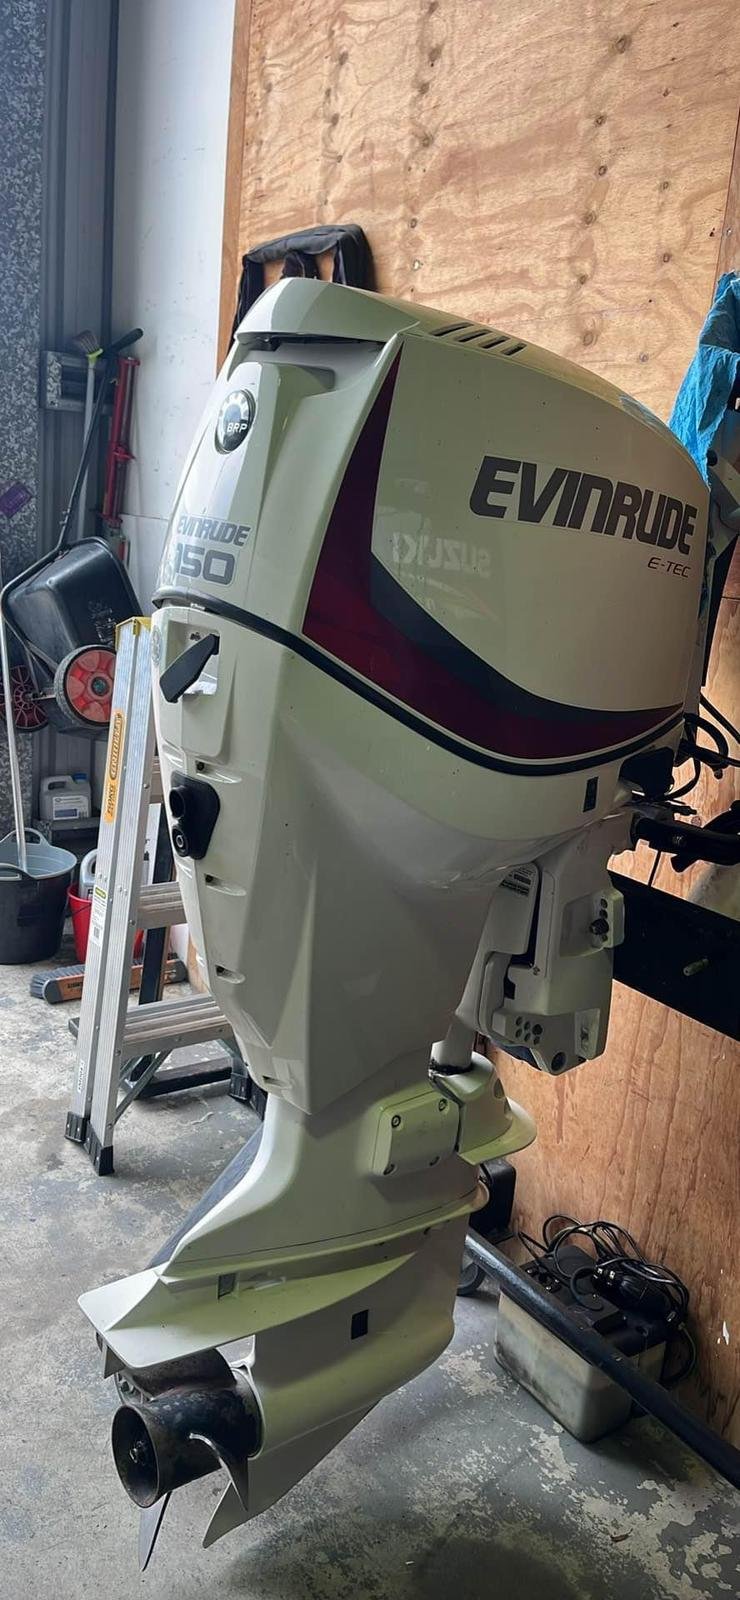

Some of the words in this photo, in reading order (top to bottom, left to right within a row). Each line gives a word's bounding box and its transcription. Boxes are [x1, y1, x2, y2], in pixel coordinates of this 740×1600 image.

[227, 422, 248, 433] BRP
[469, 455, 698, 555] EVINRUDE
[178, 516, 251, 546] EVINRUDE
[175, 542, 236, 585] 150
[647, 557, 692, 578] E-TEC
